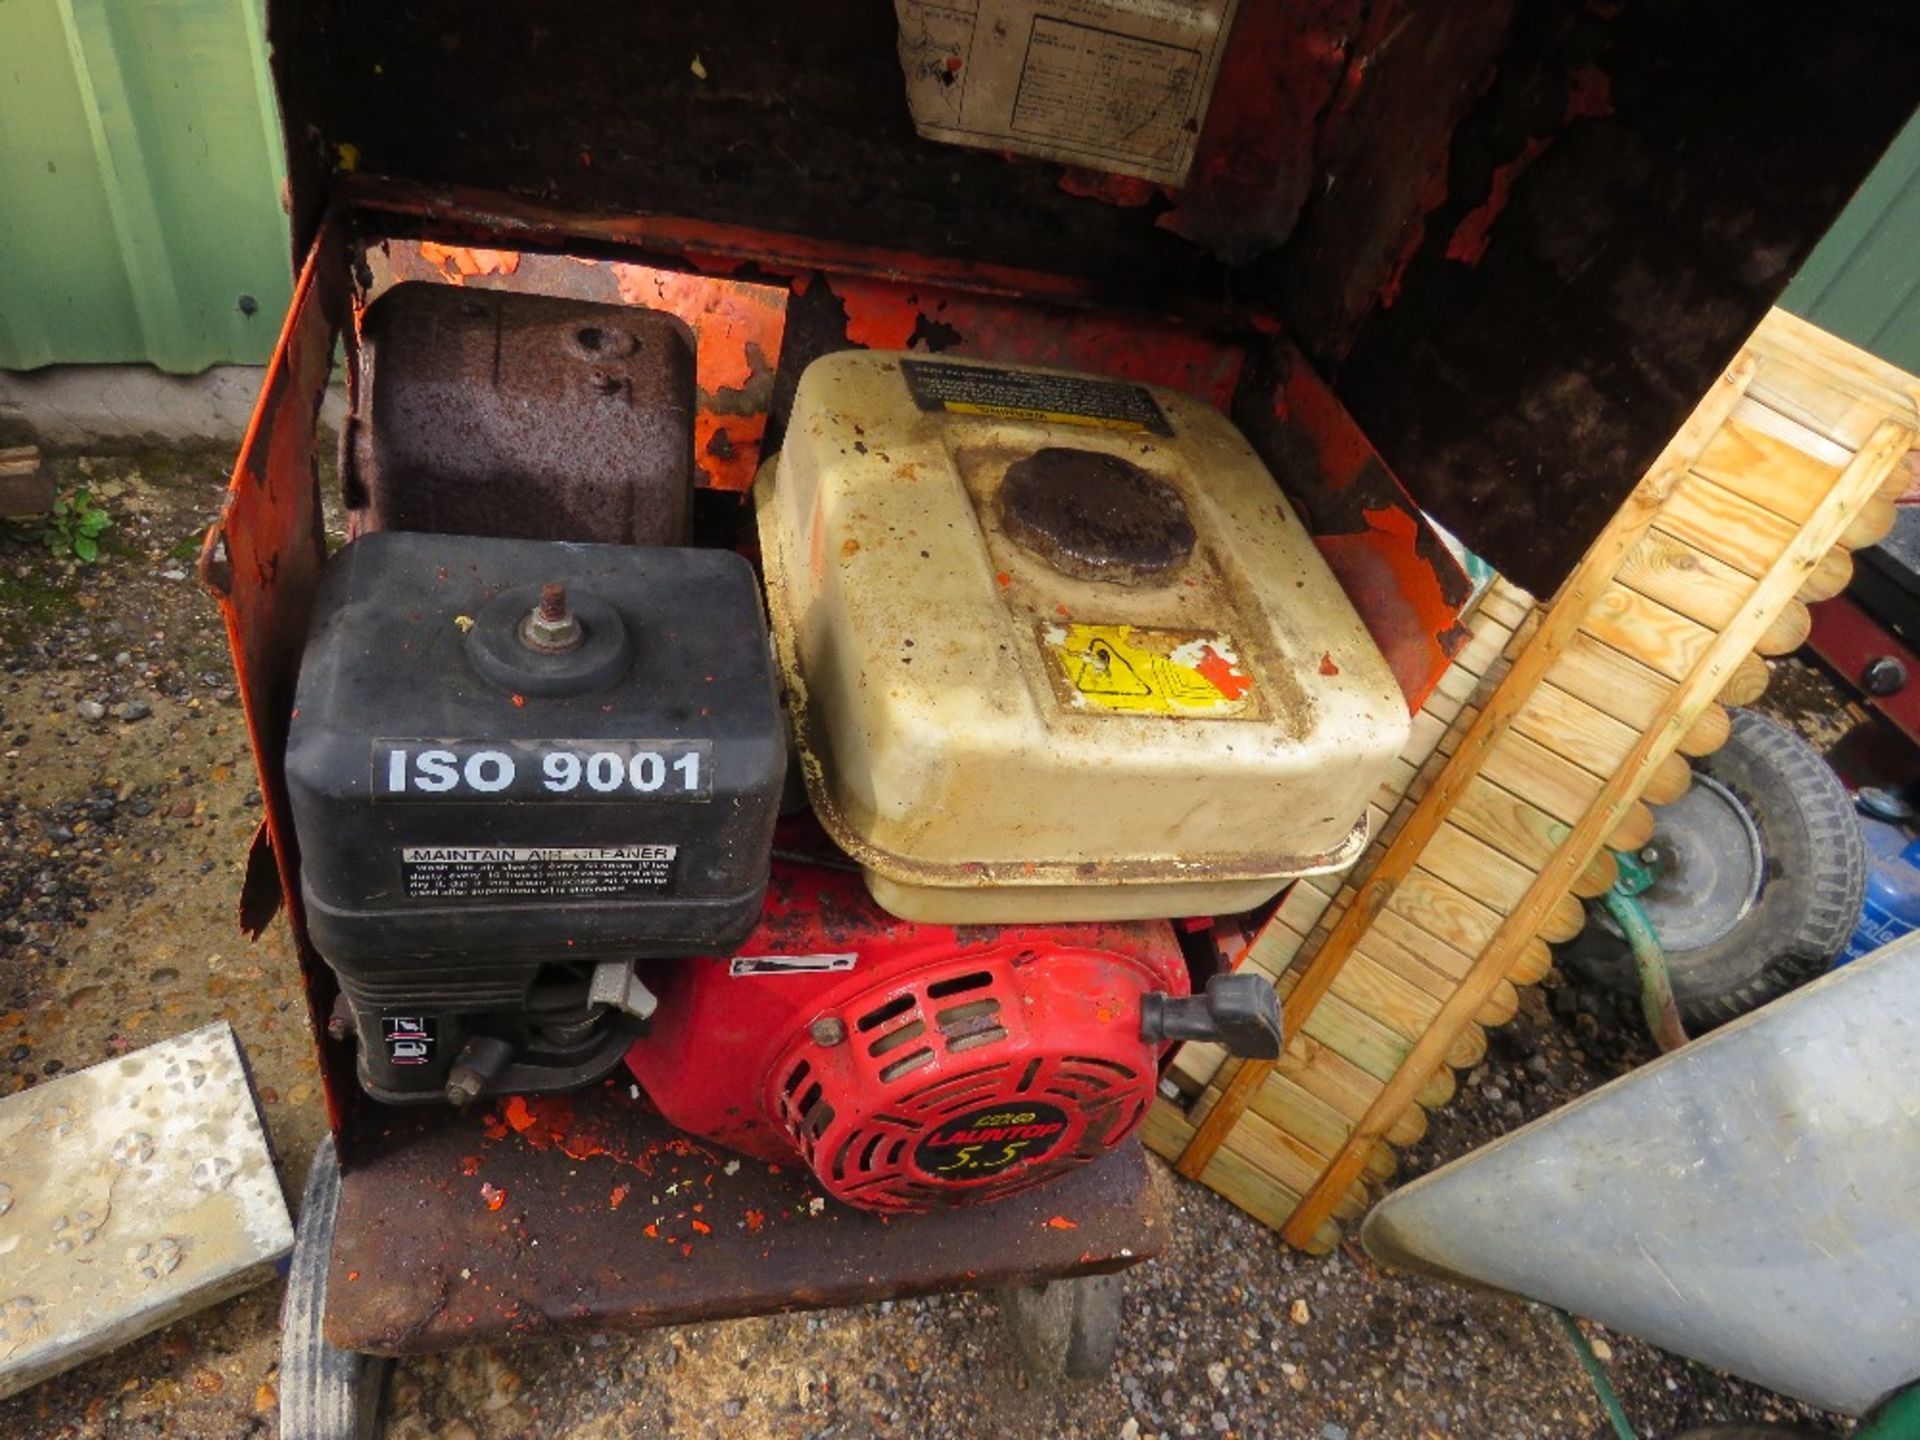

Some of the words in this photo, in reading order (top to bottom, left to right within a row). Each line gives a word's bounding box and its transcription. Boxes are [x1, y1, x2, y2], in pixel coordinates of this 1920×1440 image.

[389, 750, 516, 793] ISO
[542, 751, 700, 793] 9001
[414, 849, 516, 861] MAINTAIN
[527, 848, 561, 861] AIR
[937, 1140, 1031, 1171] 5.5
